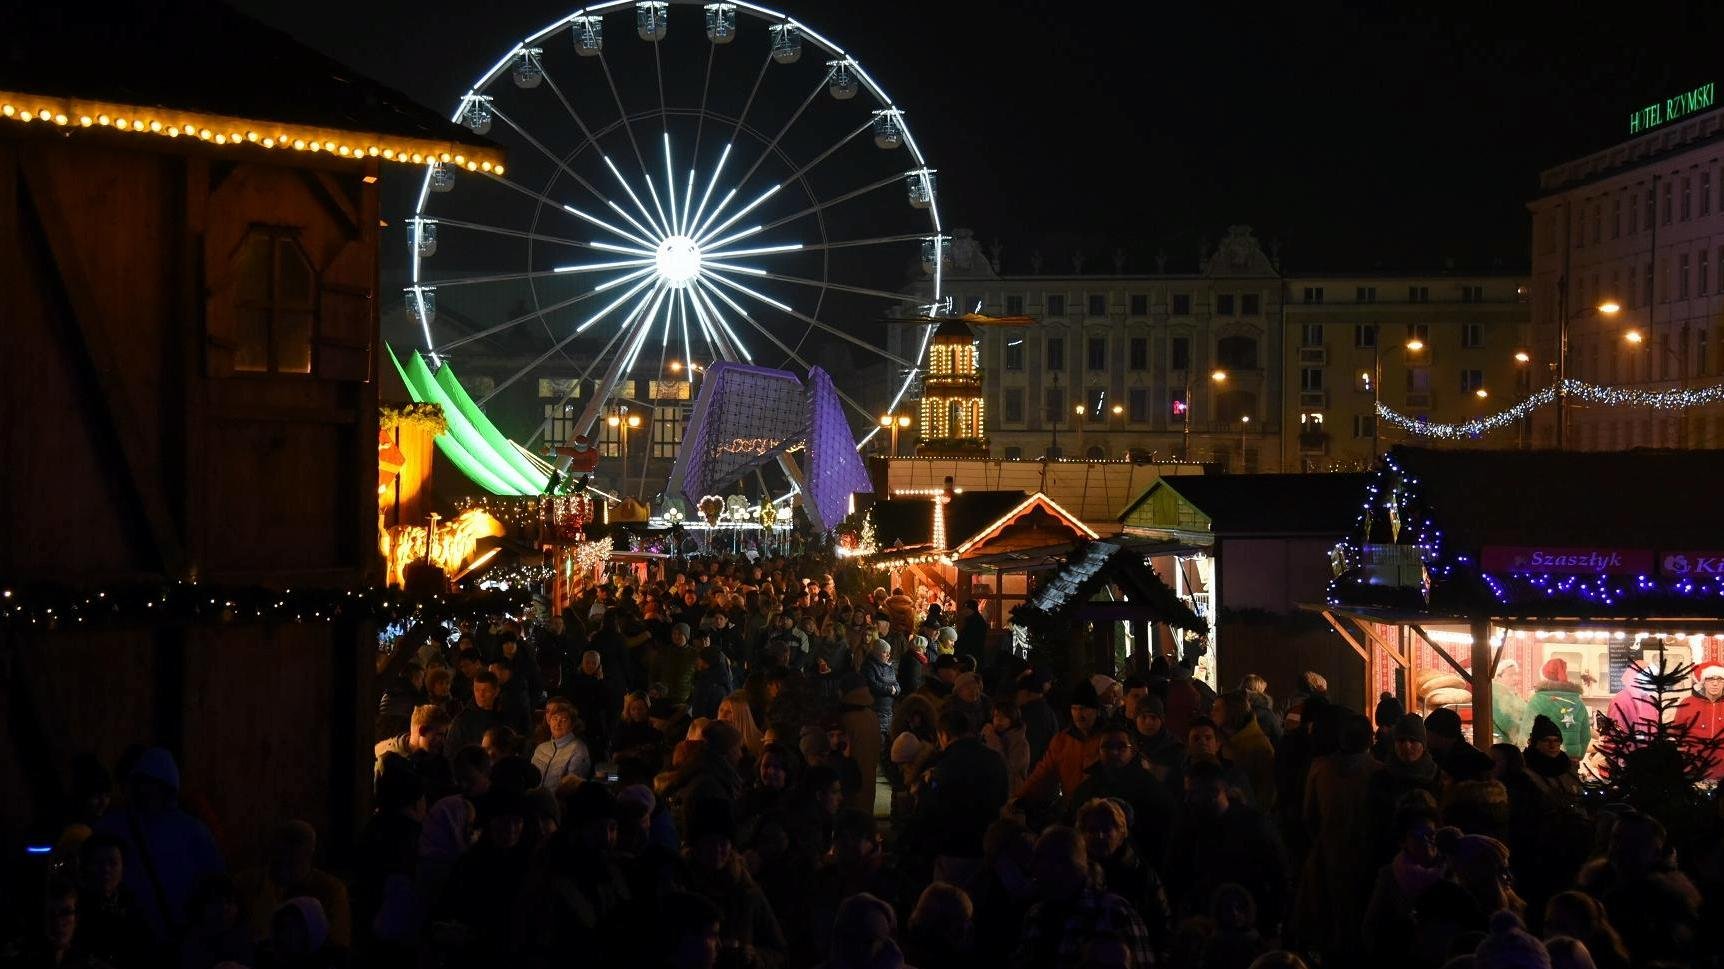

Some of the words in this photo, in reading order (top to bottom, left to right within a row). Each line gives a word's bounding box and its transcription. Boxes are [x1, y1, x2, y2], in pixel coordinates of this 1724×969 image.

[1630, 103, 1662, 134] HOTEL
[1666, 82, 1714, 121] RZYMSKI
[1532, 552, 1622, 570] Szaszłyk
